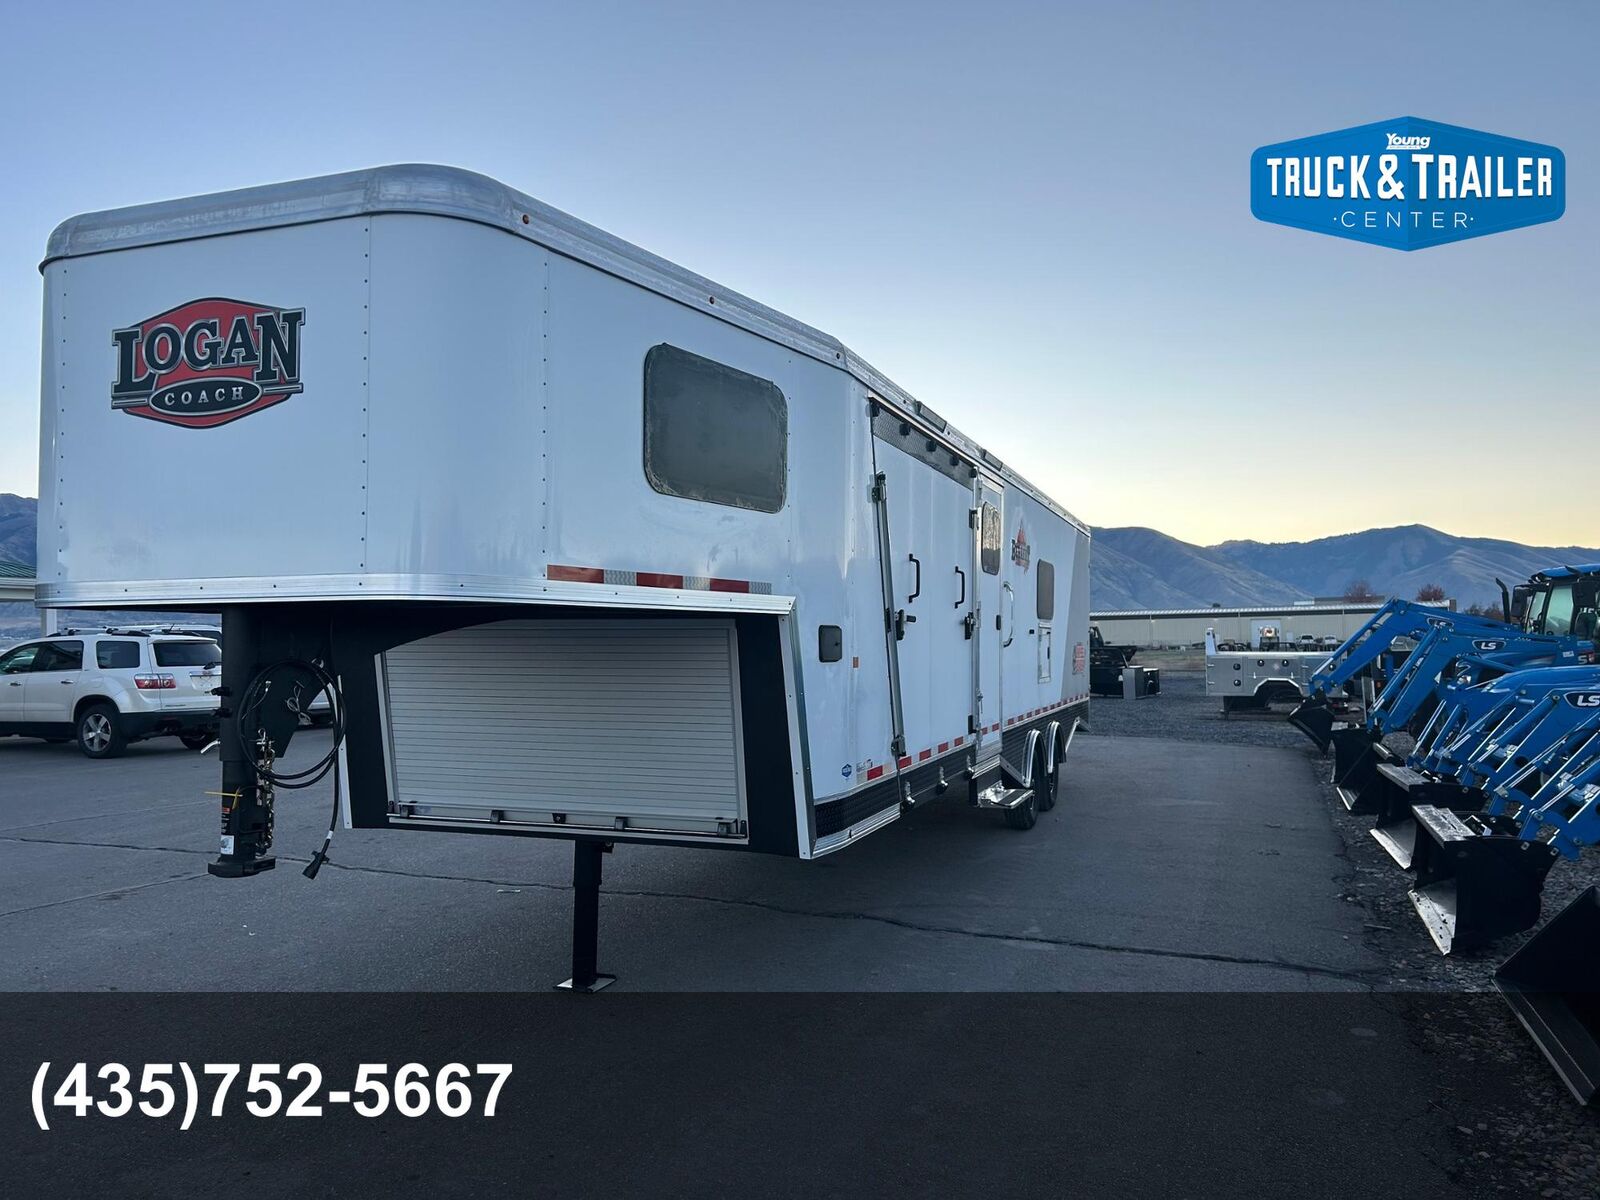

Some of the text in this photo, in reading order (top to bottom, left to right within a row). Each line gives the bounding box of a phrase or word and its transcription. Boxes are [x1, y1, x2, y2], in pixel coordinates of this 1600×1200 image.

[112, 308, 305, 394] LOGAN
[164, 386, 244, 406] COACH
[1481, 642, 1496, 650] LS
[1577, 695, 1600, 707] LS
